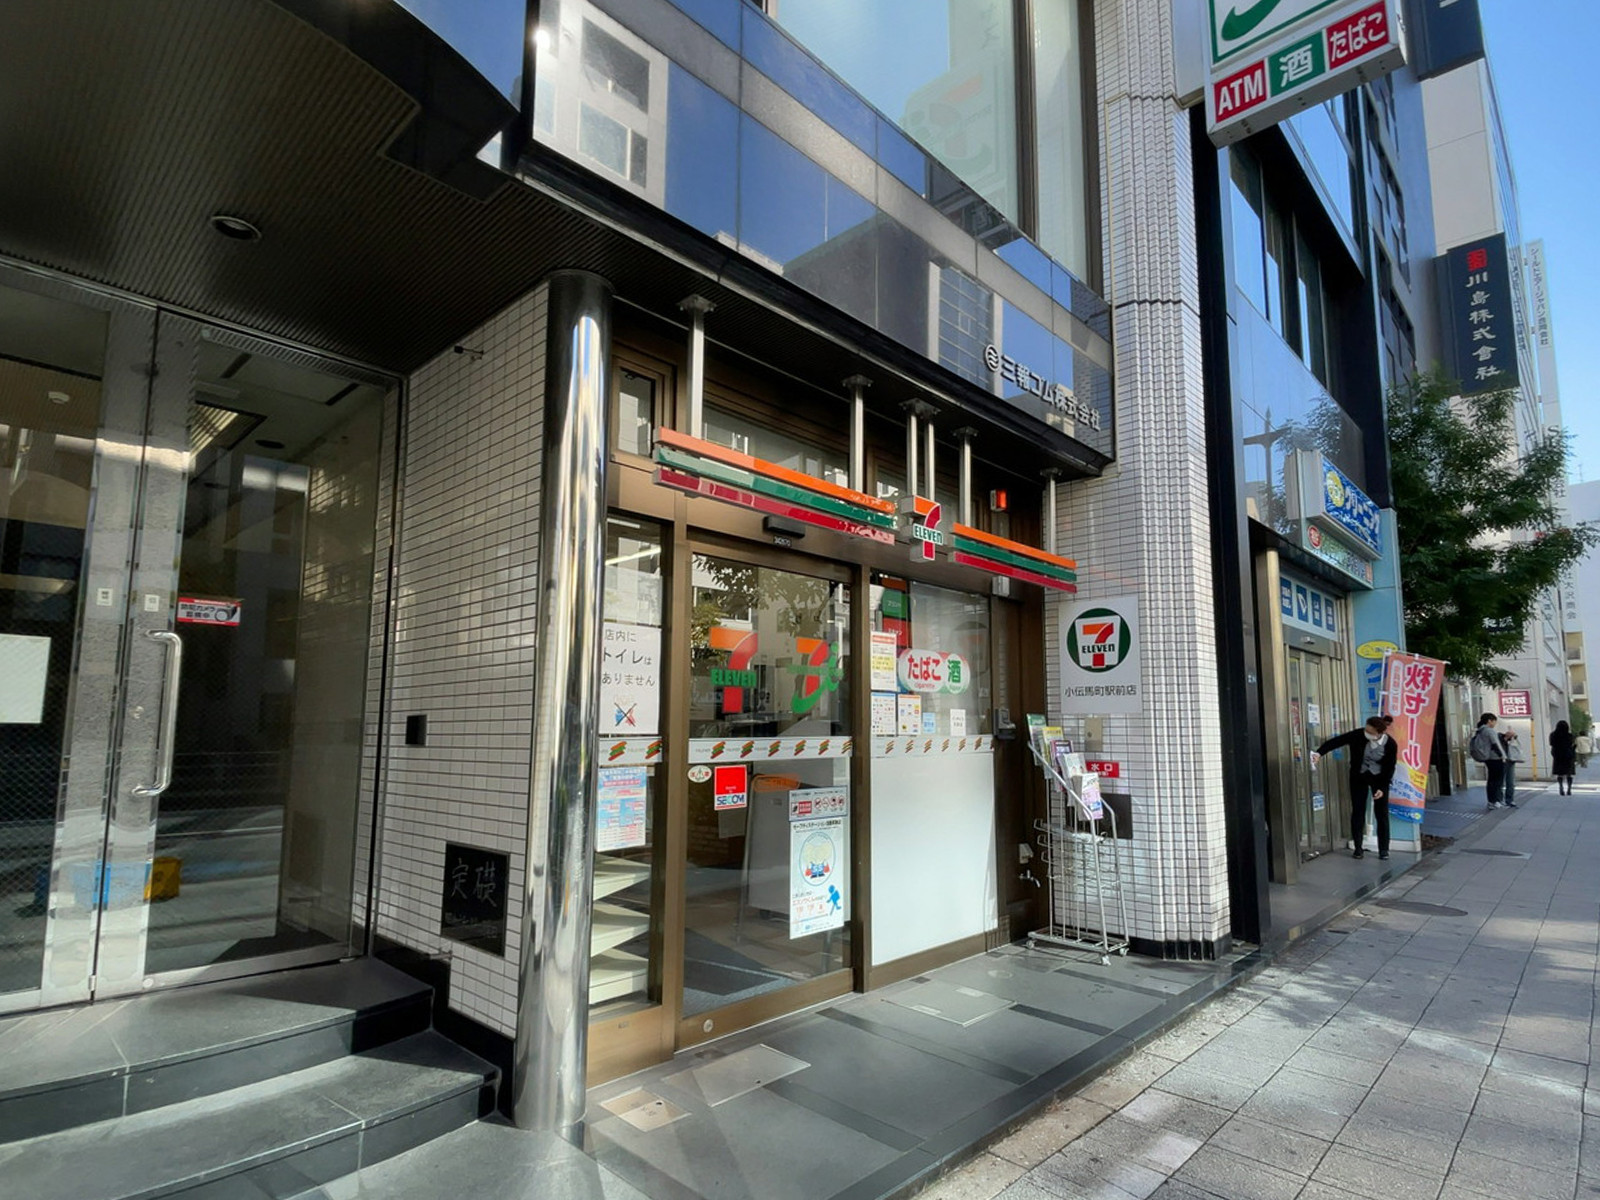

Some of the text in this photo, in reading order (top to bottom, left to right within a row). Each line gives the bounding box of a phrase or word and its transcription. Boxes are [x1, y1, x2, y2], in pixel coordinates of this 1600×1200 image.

[1329, 12, 1387, 59] たばこ
[1280, 45, 1313, 87] 酒
[1217, 68, 1264, 116] ATM
[604, 629, 637, 642] 店内に
[1082, 622, 1115, 667] 7
[603, 647, 652, 665] トイレは
[907, 654, 942, 681] たばこ
[602, 672, 656, 687] ありません
[709, 626, 758, 714] 7
[947, 659, 962, 684] 酒
[1064, 684, 1138, 698] 小伝馬町駅前店
[716, 794, 745, 806] SECOM
